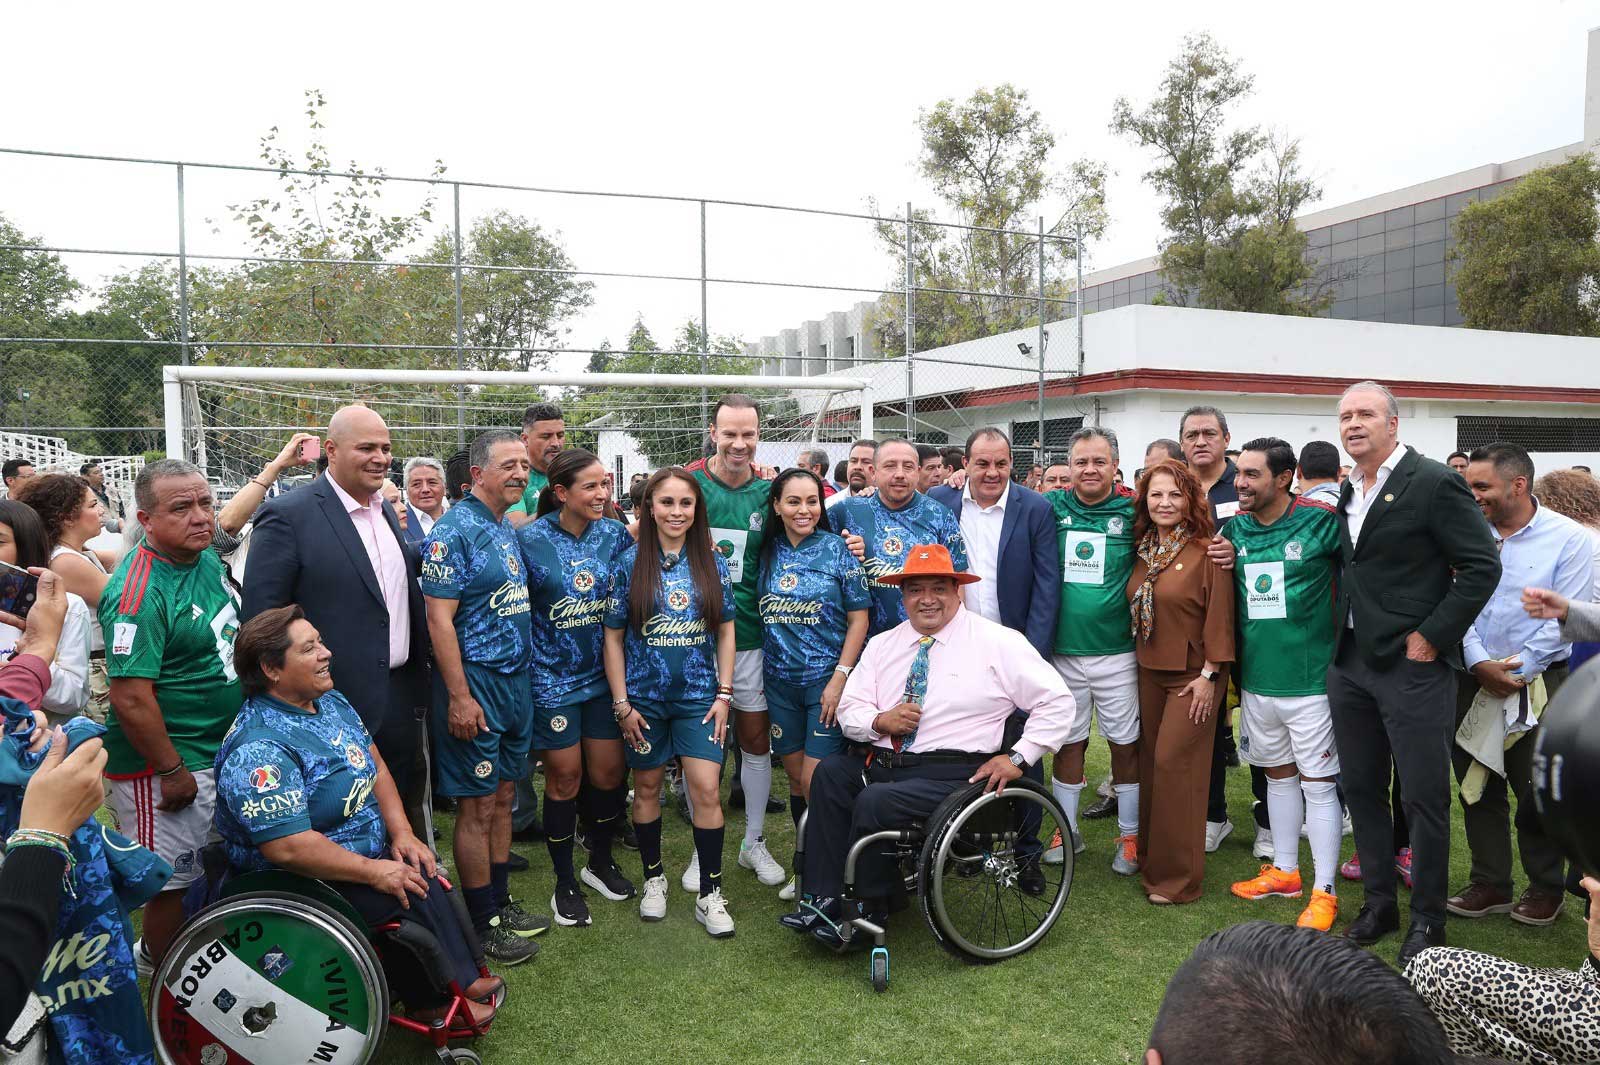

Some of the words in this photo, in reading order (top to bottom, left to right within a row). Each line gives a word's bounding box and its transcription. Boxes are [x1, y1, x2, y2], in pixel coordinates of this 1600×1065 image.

[427, 562, 454, 578] GNP
[759, 592, 823, 616] Caliente
[641, 612, 706, 637] Calient
[763, 613, 821, 625] caliente.mx
[260, 790, 302, 813] GNP
